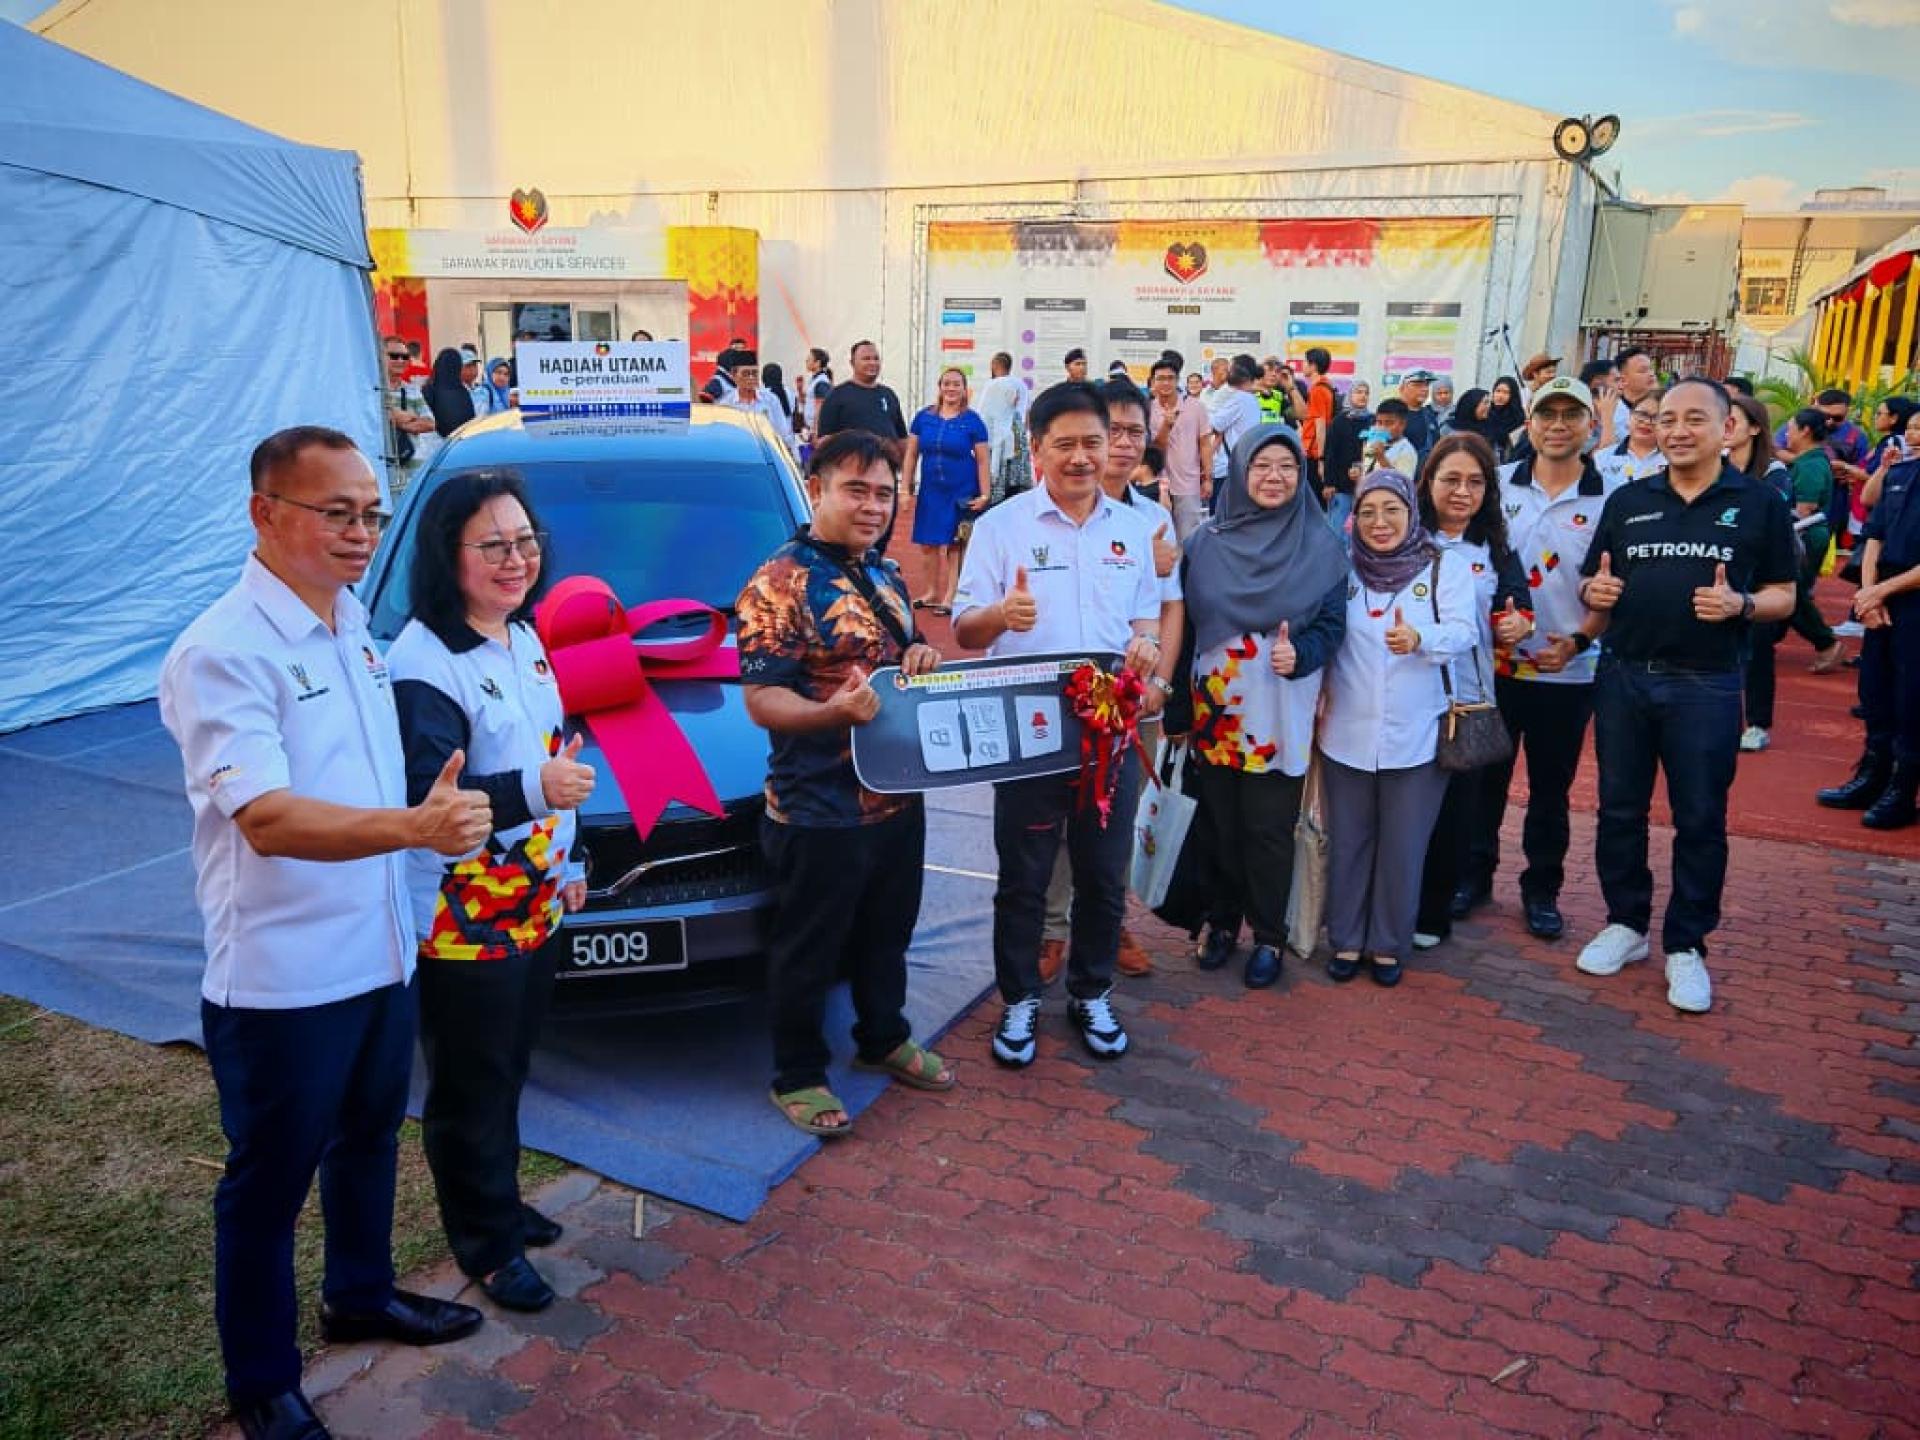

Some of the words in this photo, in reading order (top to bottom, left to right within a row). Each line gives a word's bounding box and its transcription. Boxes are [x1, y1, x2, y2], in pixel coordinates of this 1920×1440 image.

[442, 257, 498, 270] SARAWAK
[502, 257, 554, 271] PAVILION
[557, 257, 565, 269] &
[567, 256, 625, 269] SERVICES
[539, 357, 603, 374] HADIAH
[608, 357, 667, 373] UTAMA
[560, 373, 649, 387] e-peraduan
[1626, 542, 1735, 562] PETRONAS
[573, 931, 648, 967] 5009
